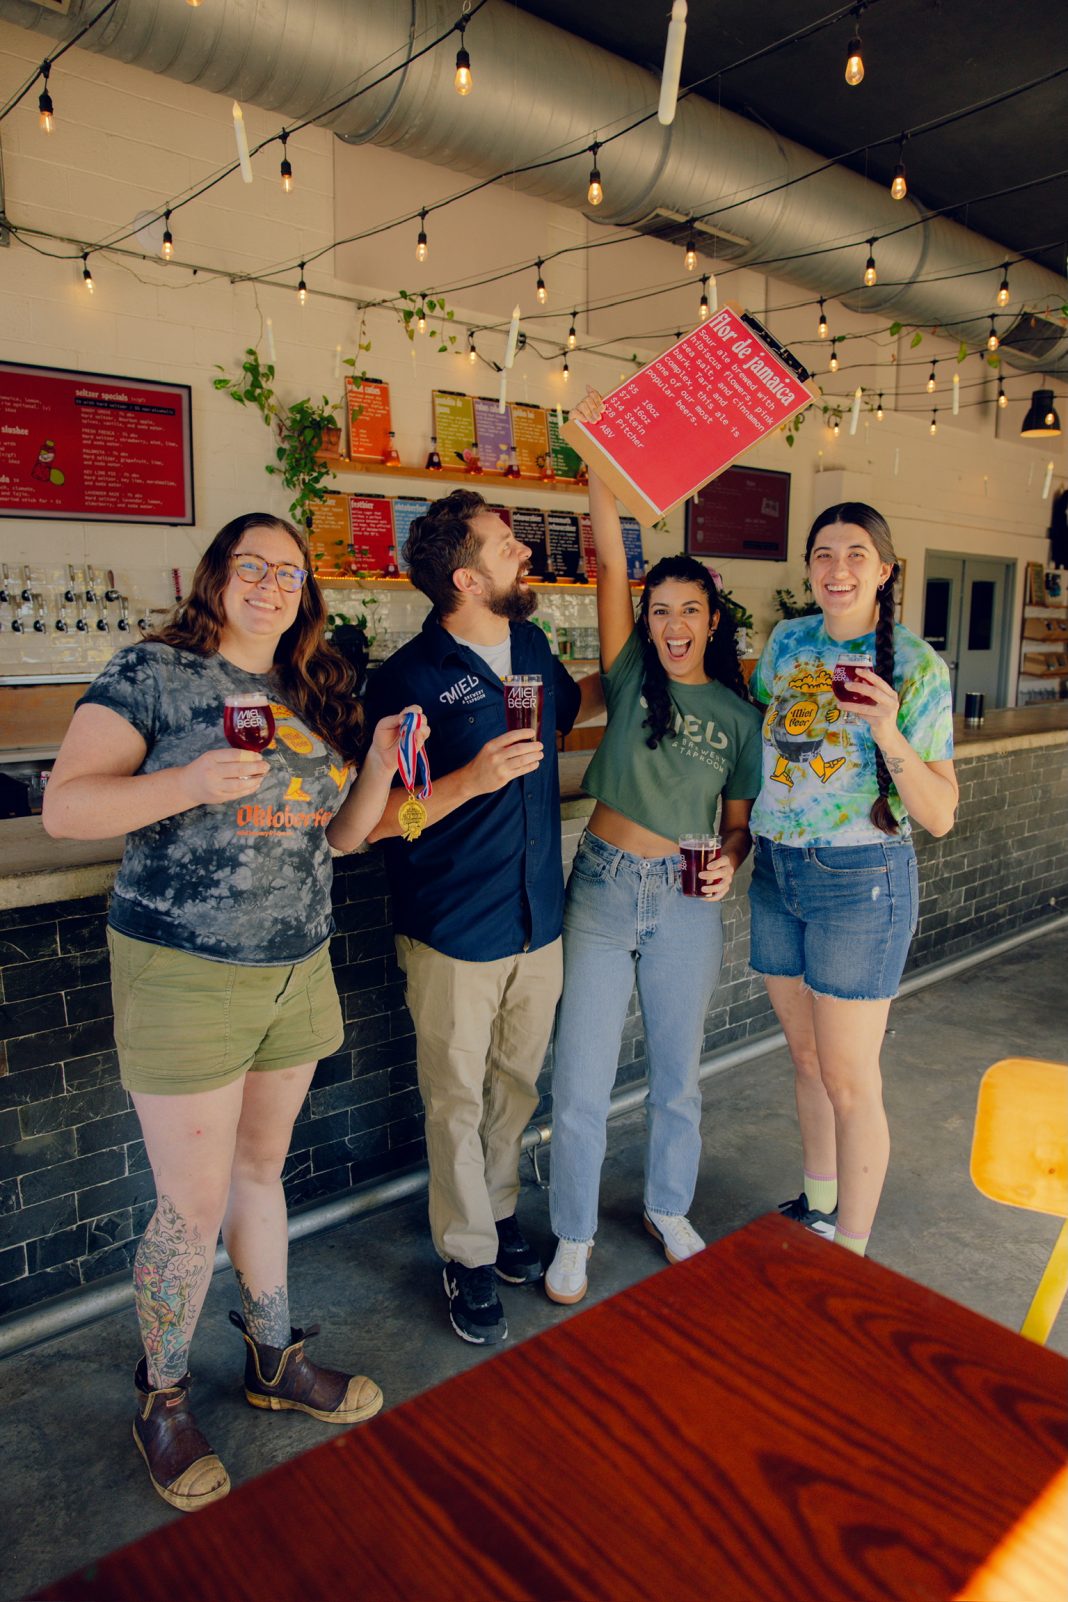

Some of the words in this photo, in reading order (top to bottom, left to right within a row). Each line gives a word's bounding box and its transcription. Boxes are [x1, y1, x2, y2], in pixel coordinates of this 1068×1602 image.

[698, 329, 716, 346] Sour
[716, 349, 730, 363] ale
[731, 363, 757, 390] brewed
[757, 391, 775, 410] with
[709, 313, 739, 342] flor
[731, 338, 752, 358] de
[742, 352, 795, 406] jamaica
[628, 383, 639, 394] $5
[672, 348, 690, 370] bark.
[695, 371, 712, 391] Tart
[712, 392, 728, 406] and
[681, 343, 695, 357] sea
[695, 358, 714, 380] salt,
[717, 382, 733, 396] and
[732, 398, 764, 432] cinnamon
[689, 335, 721, 370] hibiscus
[723, 371, 752, 405] flowers,
[754, 406, 774, 425] pink
[75, 388, 99, 398] seltzer
[101, 392, 128, 401] specials
[619, 390, 630, 400] $7
[645, 369, 675, 397] popular
[675, 399, 697, 425] beers.
[655, 362, 669, 376] one
[669, 378, 682, 387] of
[680, 390, 695, 402] our
[694, 405, 713, 424] most
[664, 356, 693, 389] complex,
[697, 391, 714, 409] this
[714, 411, 728, 425] ale
[730, 426, 739, 437] is
[600, 424, 615, 437] ABV
[610, 397, 624, 411] $14
[624, 412, 645, 435] Stein
[615, 418, 644, 447] Pitcher
[439, 674, 480, 704] MIEL
[508, 687, 537, 699] MIEL
[508, 698, 537, 709] BEER
[237, 709, 261, 719] MIEL
[237, 717, 263, 729] BEER
